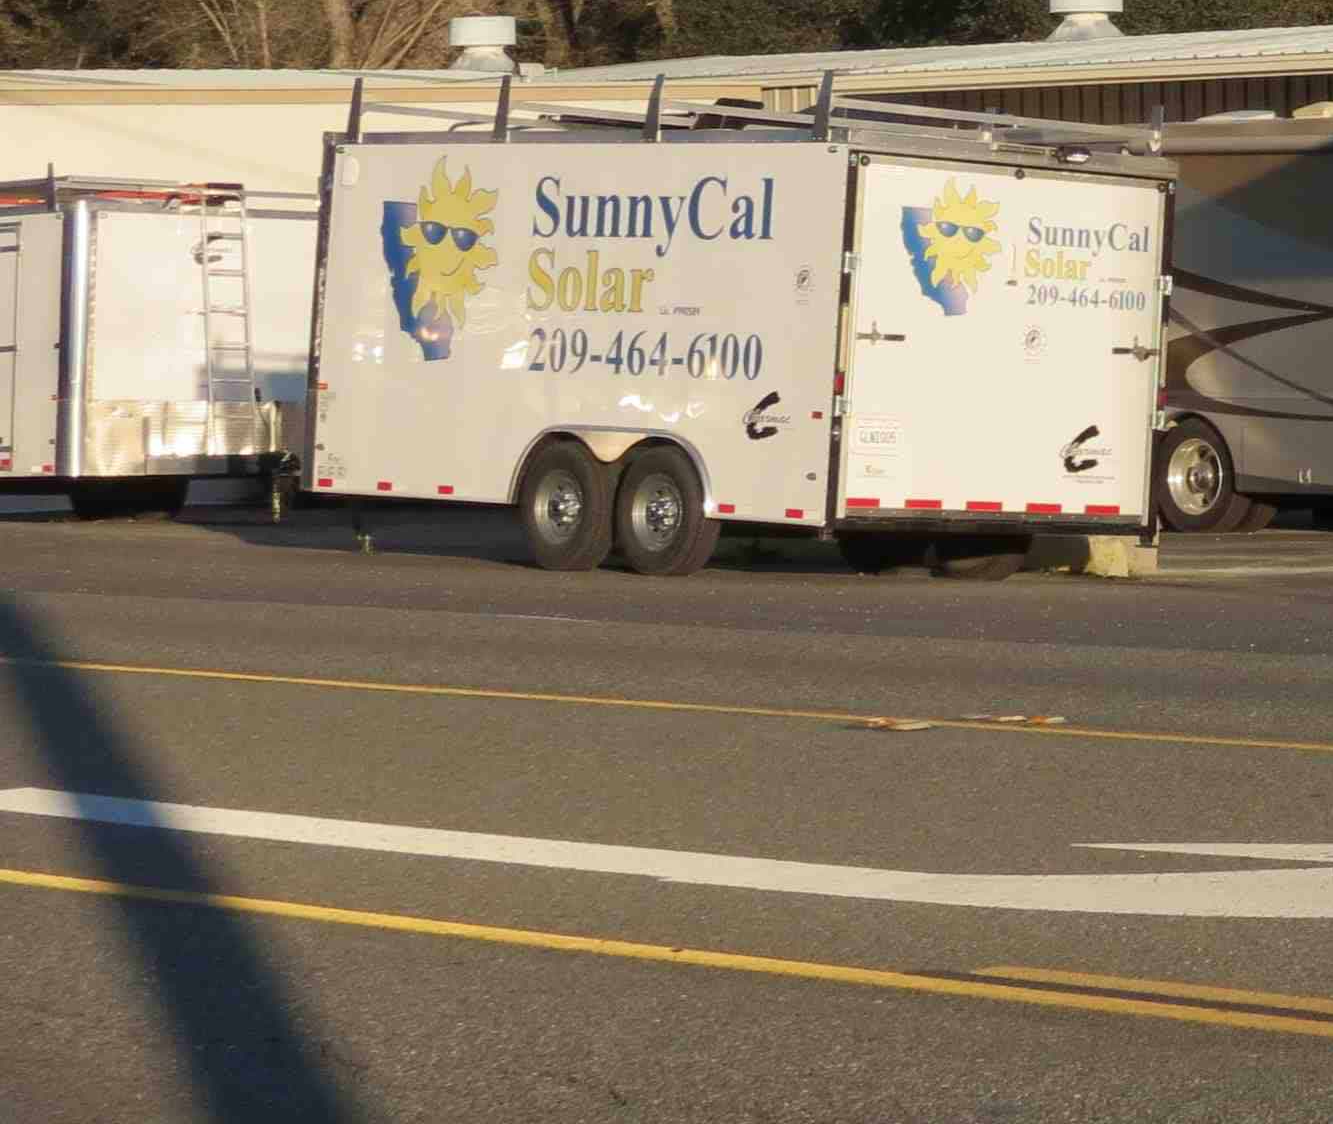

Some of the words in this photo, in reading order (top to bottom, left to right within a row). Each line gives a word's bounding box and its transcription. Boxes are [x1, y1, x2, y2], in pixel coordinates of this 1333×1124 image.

[531, 175, 775, 258] SunnyCal
[1027, 216, 1149, 258] SunnyCal
[526, 247, 655, 313] Solar
[1024, 248, 1091, 280] Solar
[1027, 284, 1146, 311] 209-464-6100
[527, 327, 763, 381] 209-464-6100
